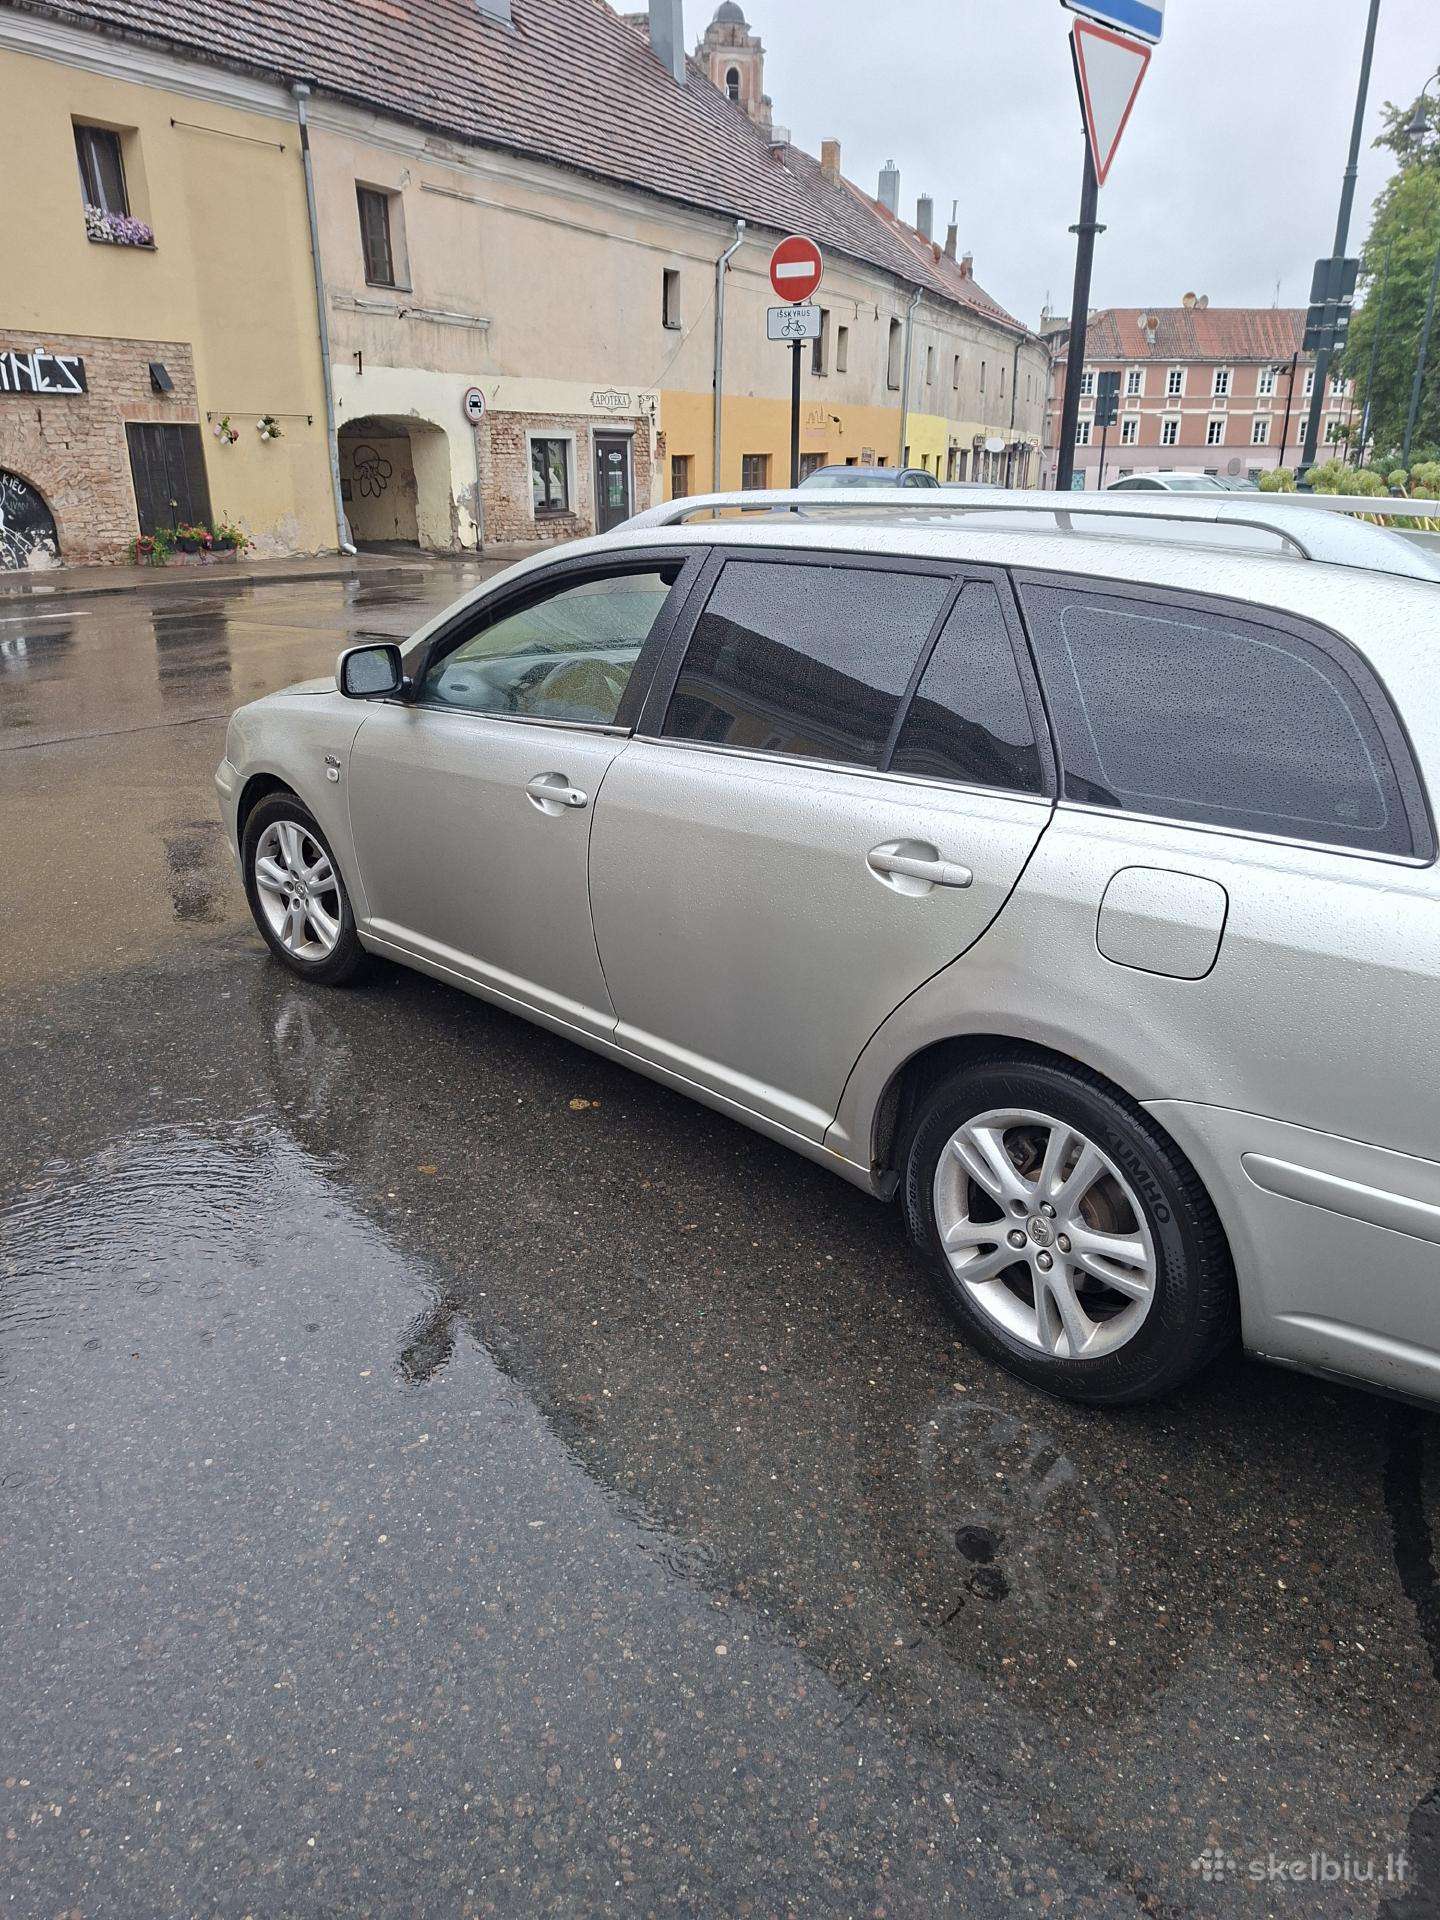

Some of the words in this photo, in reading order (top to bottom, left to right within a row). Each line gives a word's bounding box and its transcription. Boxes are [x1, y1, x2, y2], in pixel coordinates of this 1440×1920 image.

[777, 309, 811, 318] IŠSKYRUS
[595, 394, 627, 406] APOTEKA
[1105, 1127, 1171, 1224] KUMHO
